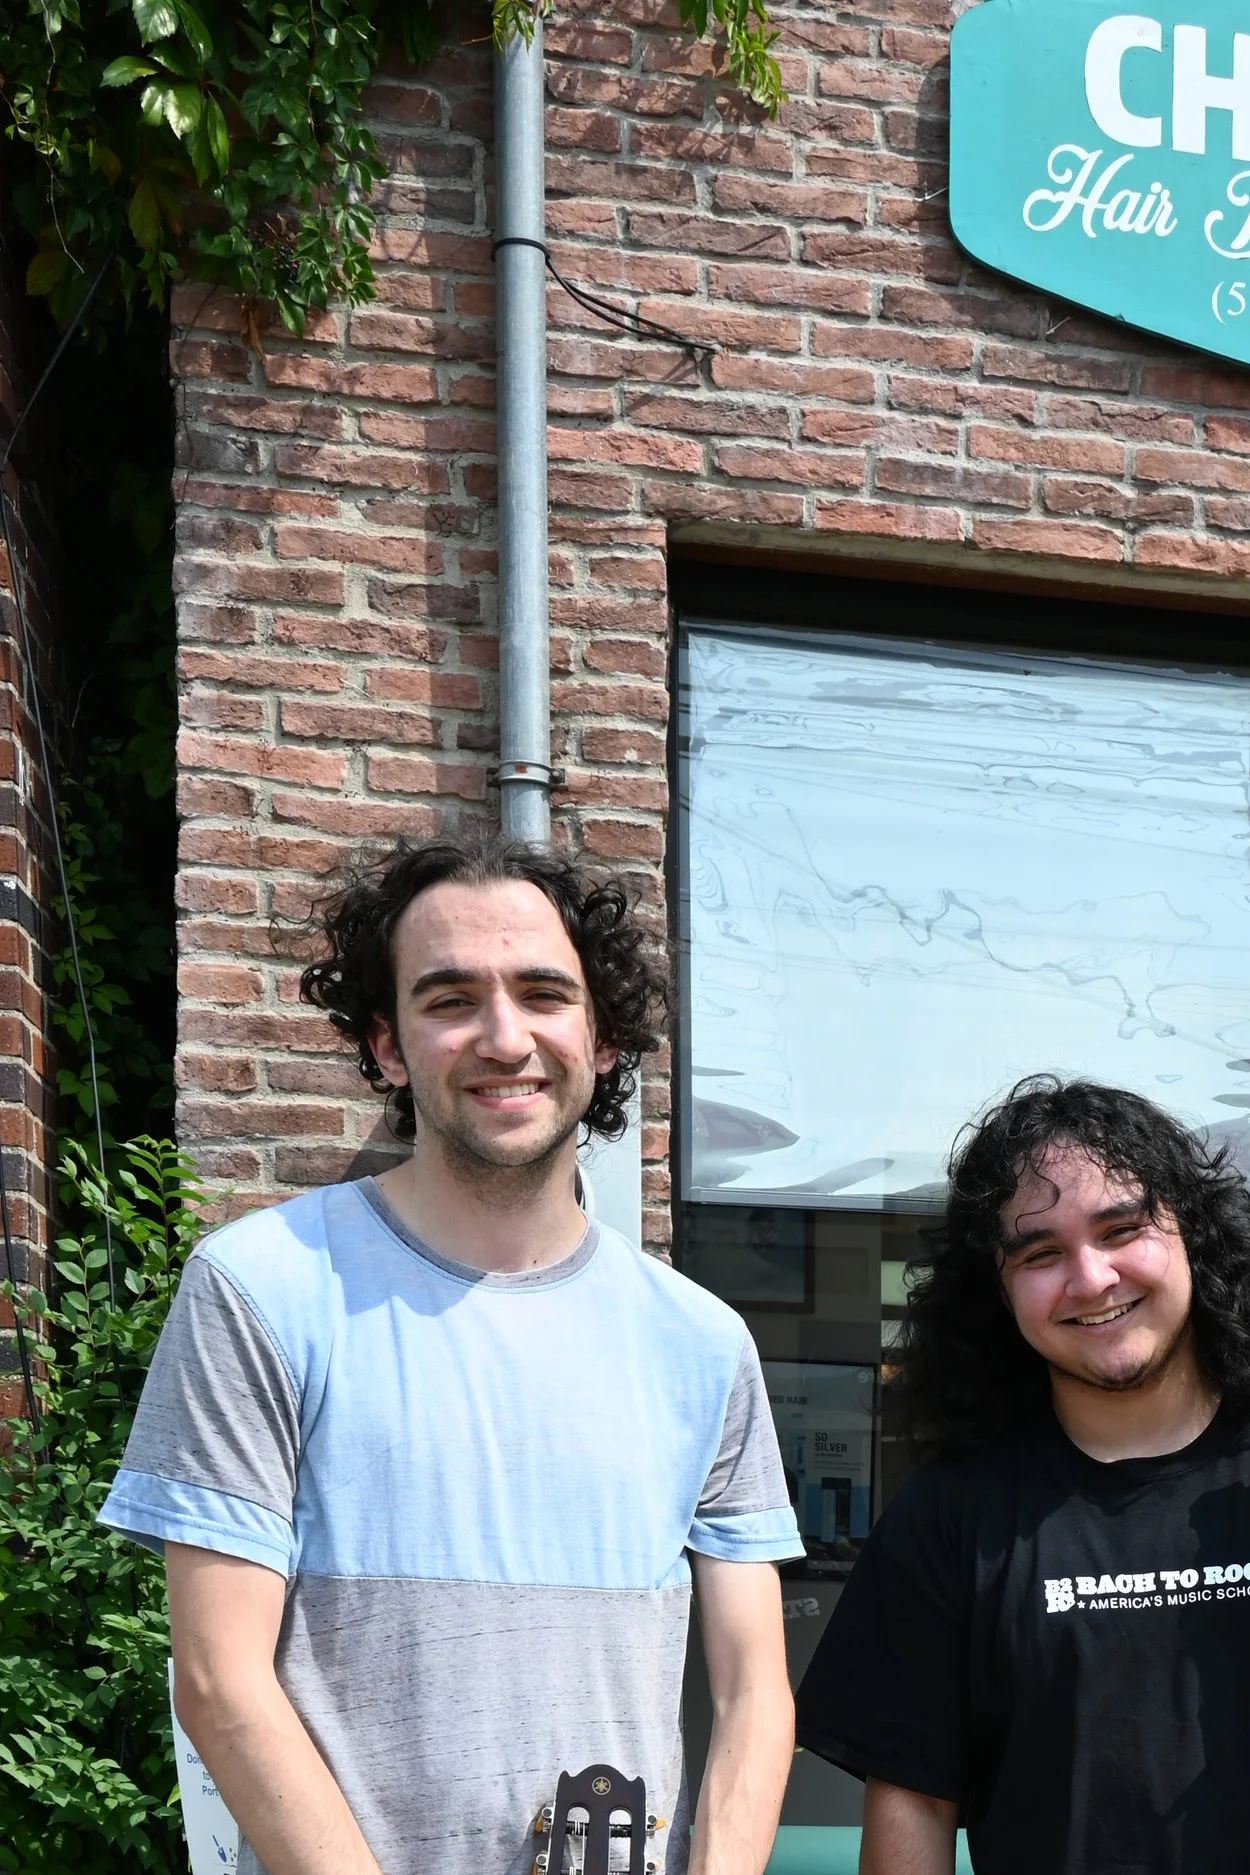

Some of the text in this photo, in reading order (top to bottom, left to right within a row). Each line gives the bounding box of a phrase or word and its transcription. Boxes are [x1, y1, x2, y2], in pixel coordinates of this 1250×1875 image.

[1022, 143, 1178, 238] Hair
[815, 1443, 848, 1453] SILVER
[1075, 1572, 1157, 1595] BACH
[1159, 1568, 1200, 1590] TO
[1089, 1595, 1163, 1610] AMERICA'S
[1167, 1589, 1212, 1606] MUSIC
